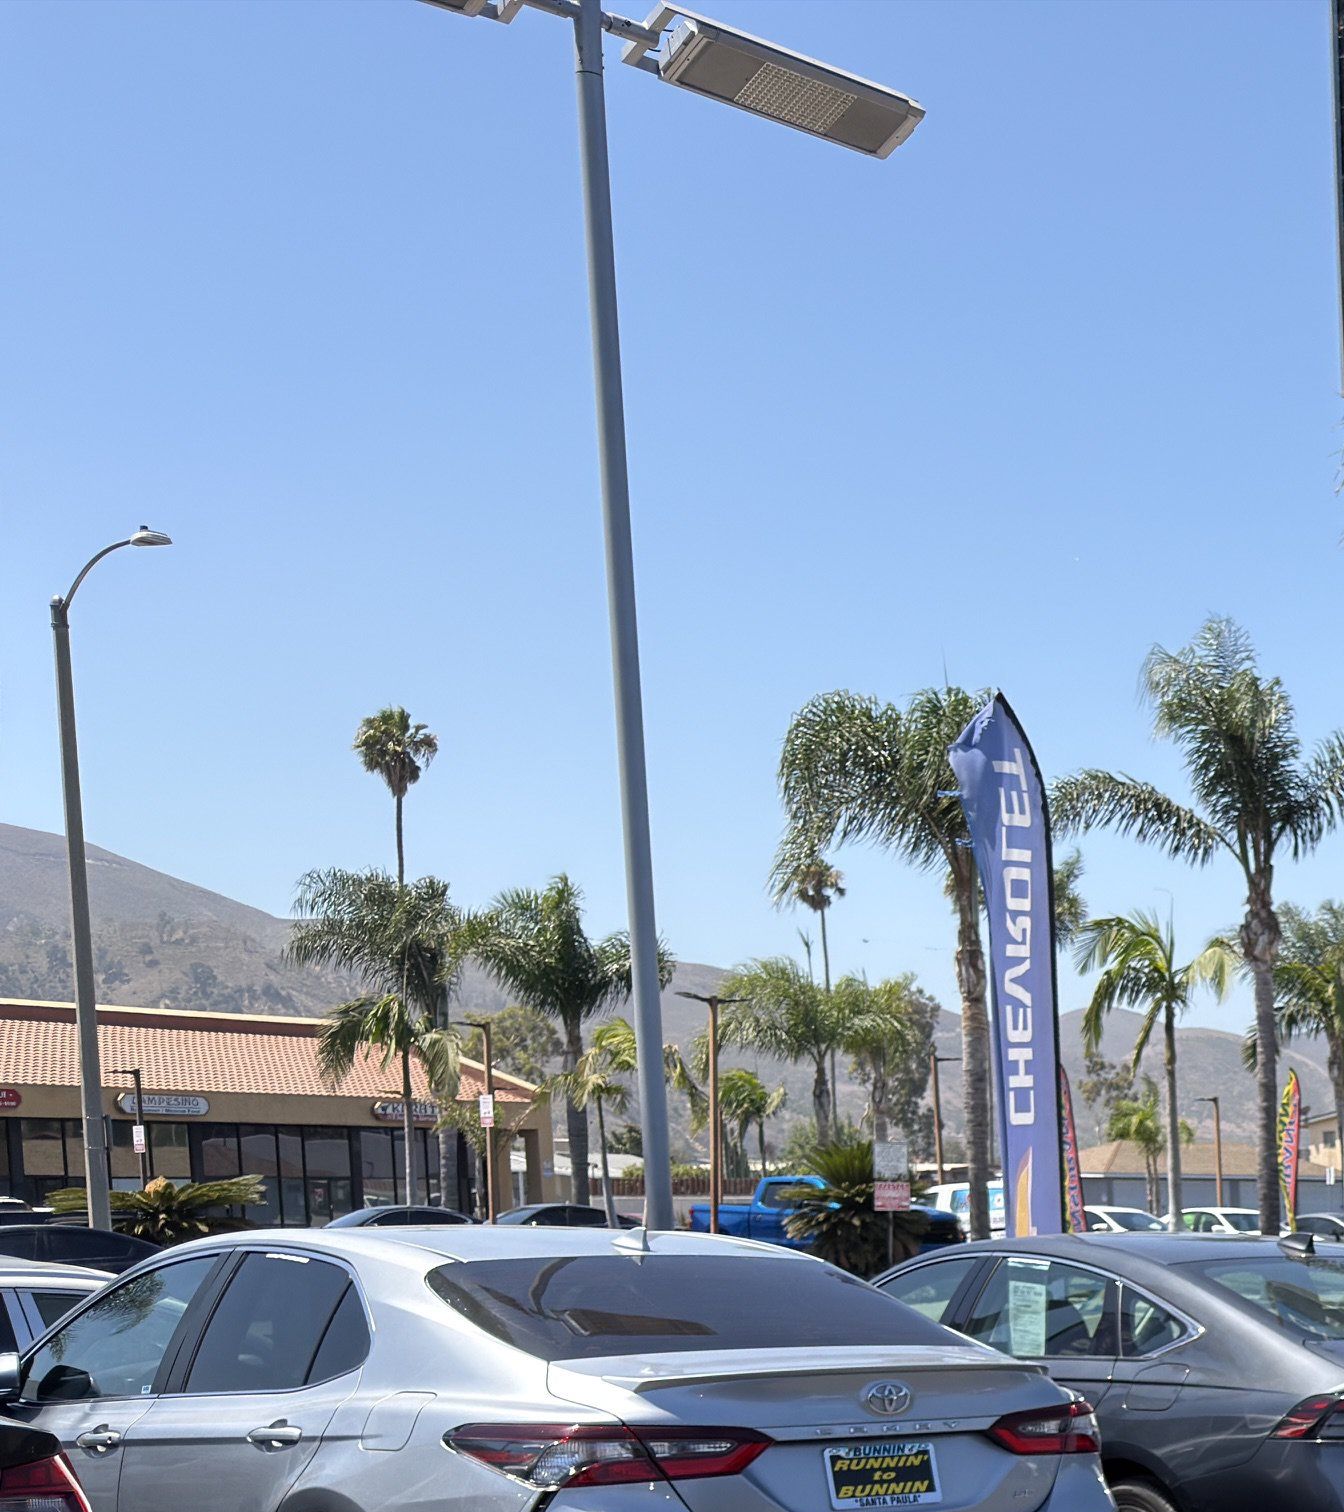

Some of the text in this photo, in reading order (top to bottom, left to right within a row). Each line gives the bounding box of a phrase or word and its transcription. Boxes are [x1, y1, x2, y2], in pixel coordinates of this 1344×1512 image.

[853, 1443, 907, 1457] BUNNIN
[834, 1454, 929, 1472] RUNNIN'
[873, 1470, 896, 1480] to
[838, 1480, 930, 1498] BUNNIN
